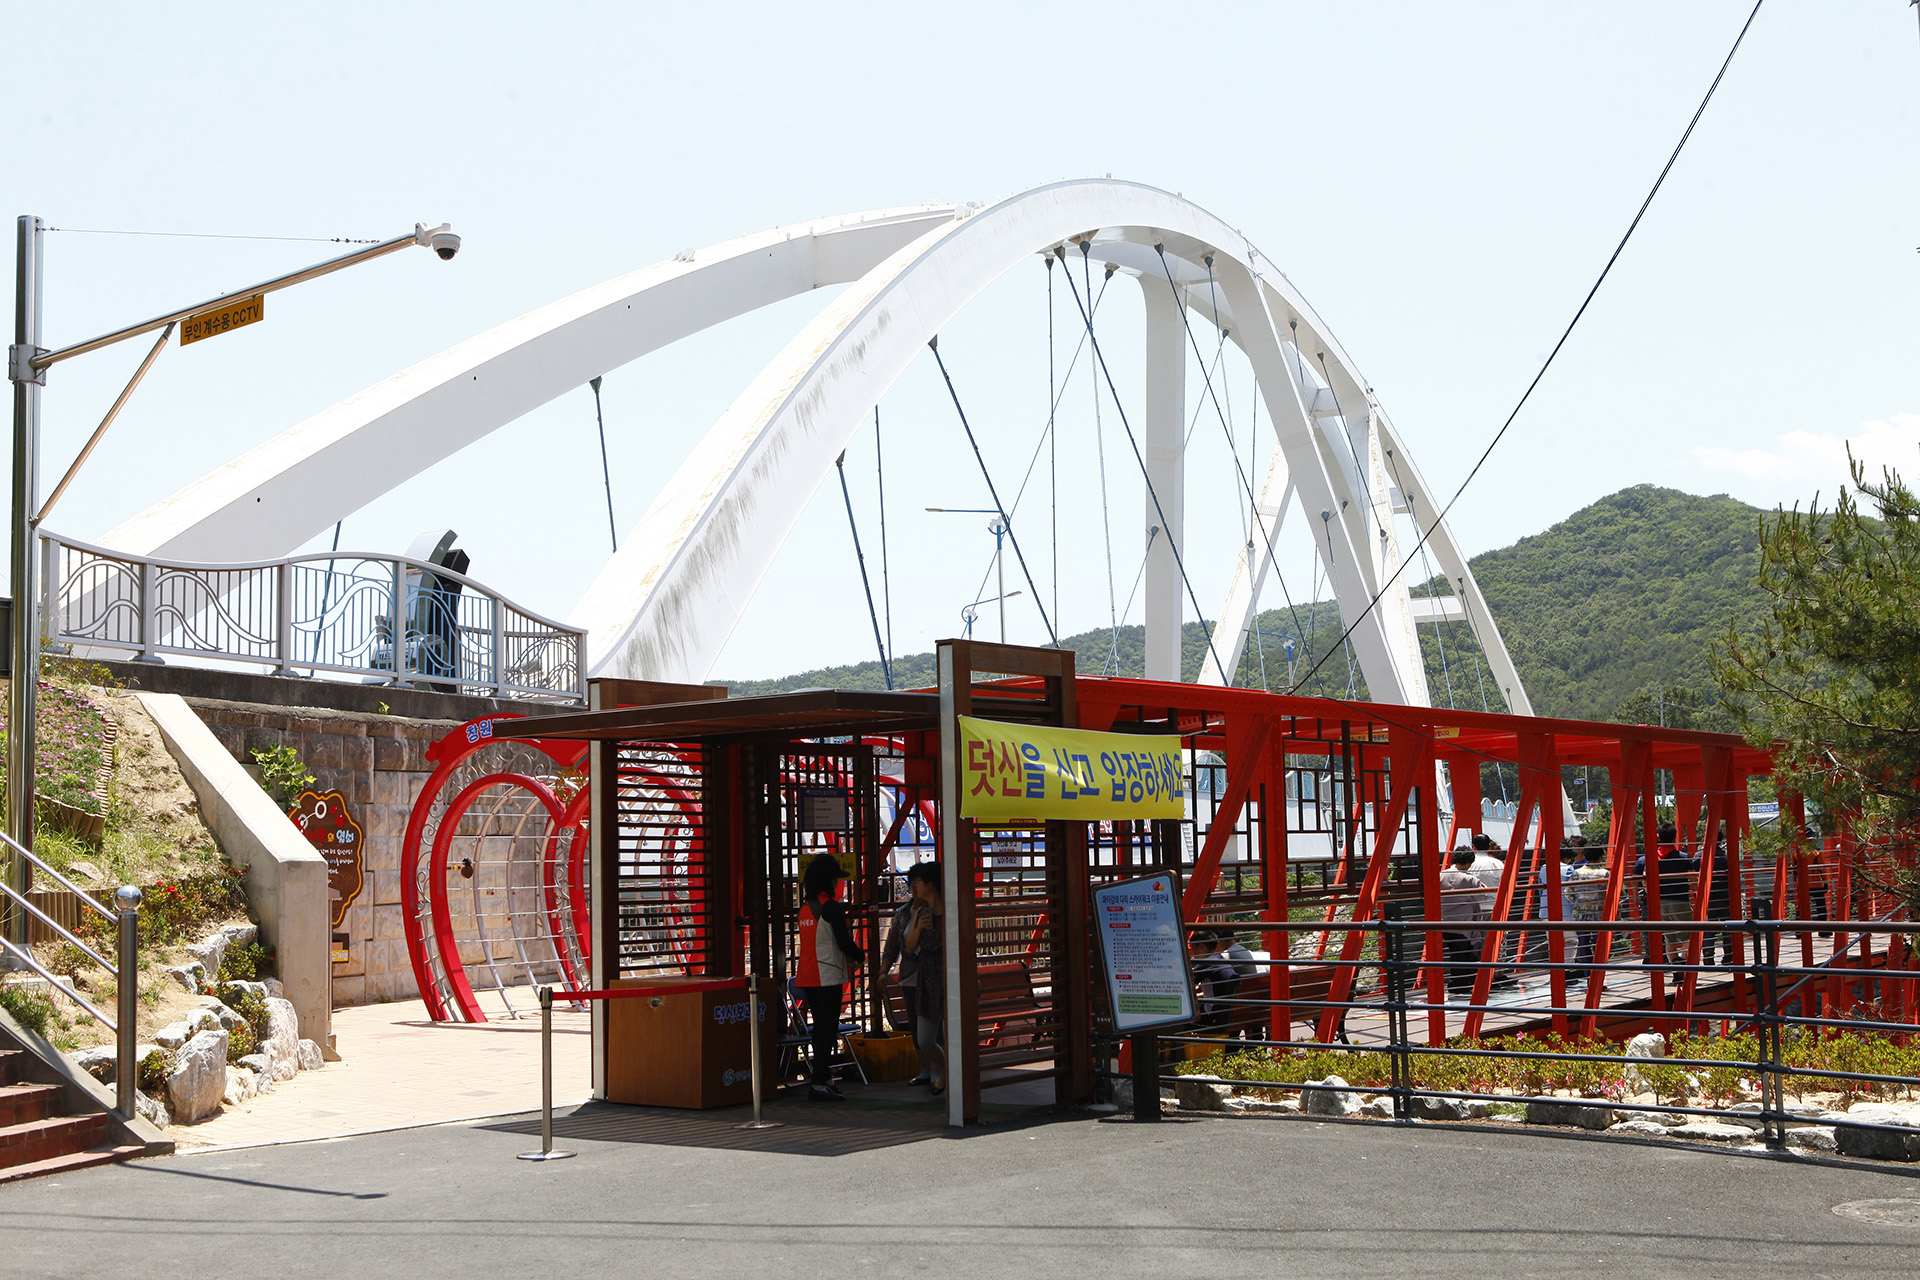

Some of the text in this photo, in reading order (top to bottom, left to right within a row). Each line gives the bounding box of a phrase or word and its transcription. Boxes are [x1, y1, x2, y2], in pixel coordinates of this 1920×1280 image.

[184, 303, 260, 341] 무인 계수용 CCTV
[968, 738, 1184, 804] 덧신을 신고 입장하세요
[1120, 894, 1129, 905] 다리
